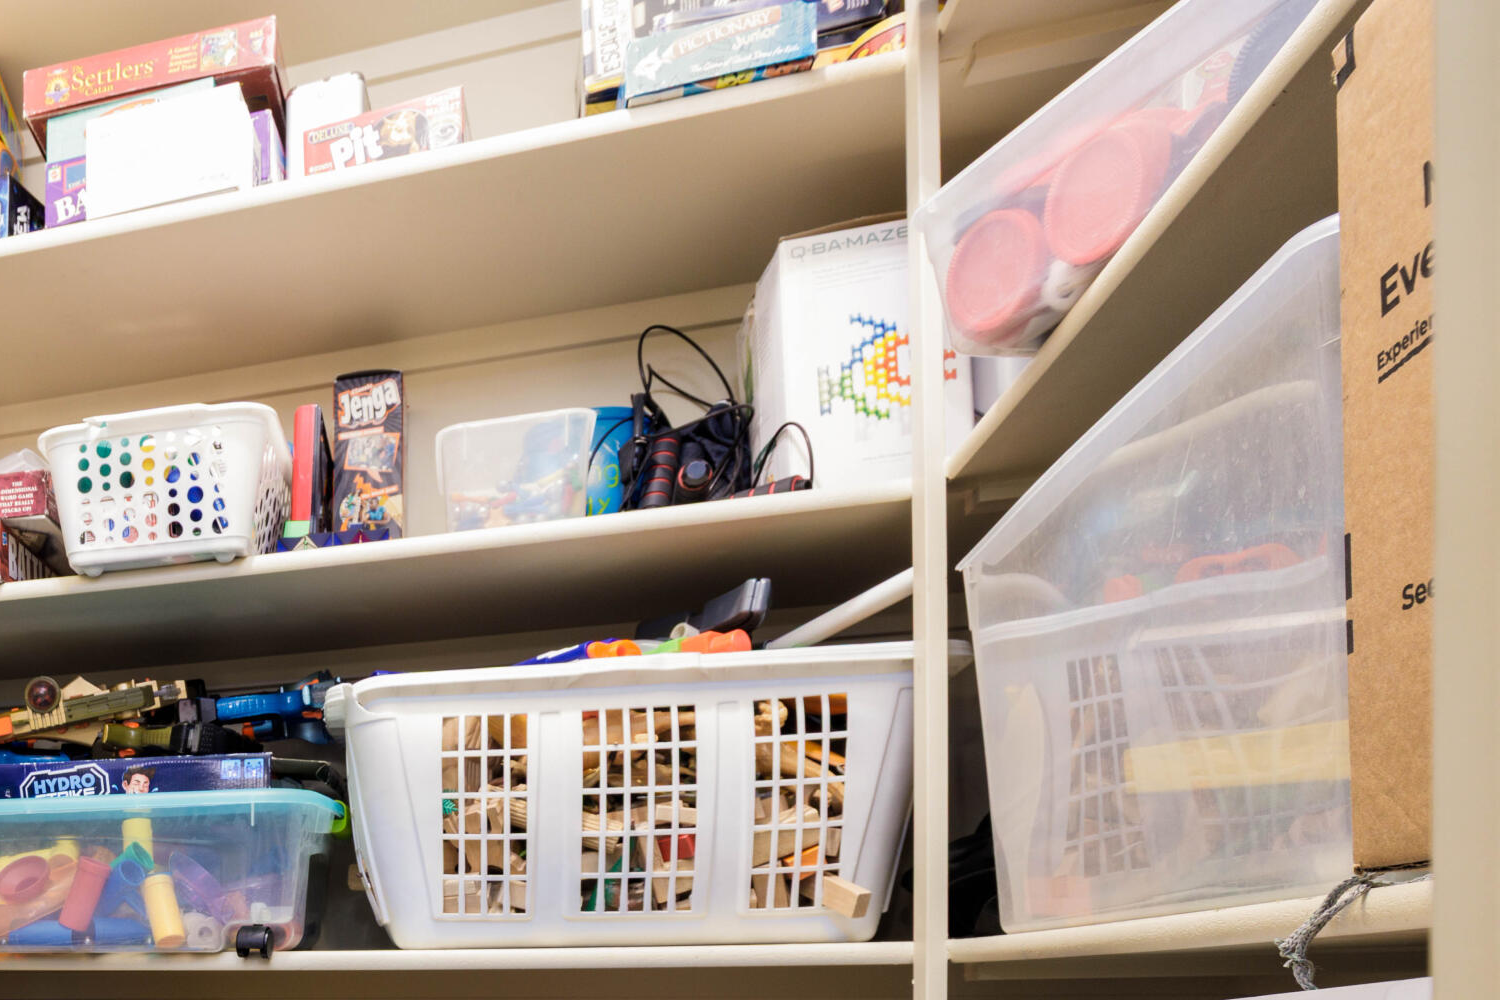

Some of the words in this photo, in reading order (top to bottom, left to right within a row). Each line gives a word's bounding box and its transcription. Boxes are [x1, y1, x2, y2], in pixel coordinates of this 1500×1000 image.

[679, 10, 772, 54] PICTIONARY
[732, 24, 780, 51] Junior
[71, 60, 156, 91] Settlers
[330, 125, 384, 170] Pit
[340, 380, 400, 425] Jenga
[34, 772, 96, 795] HYDRO
